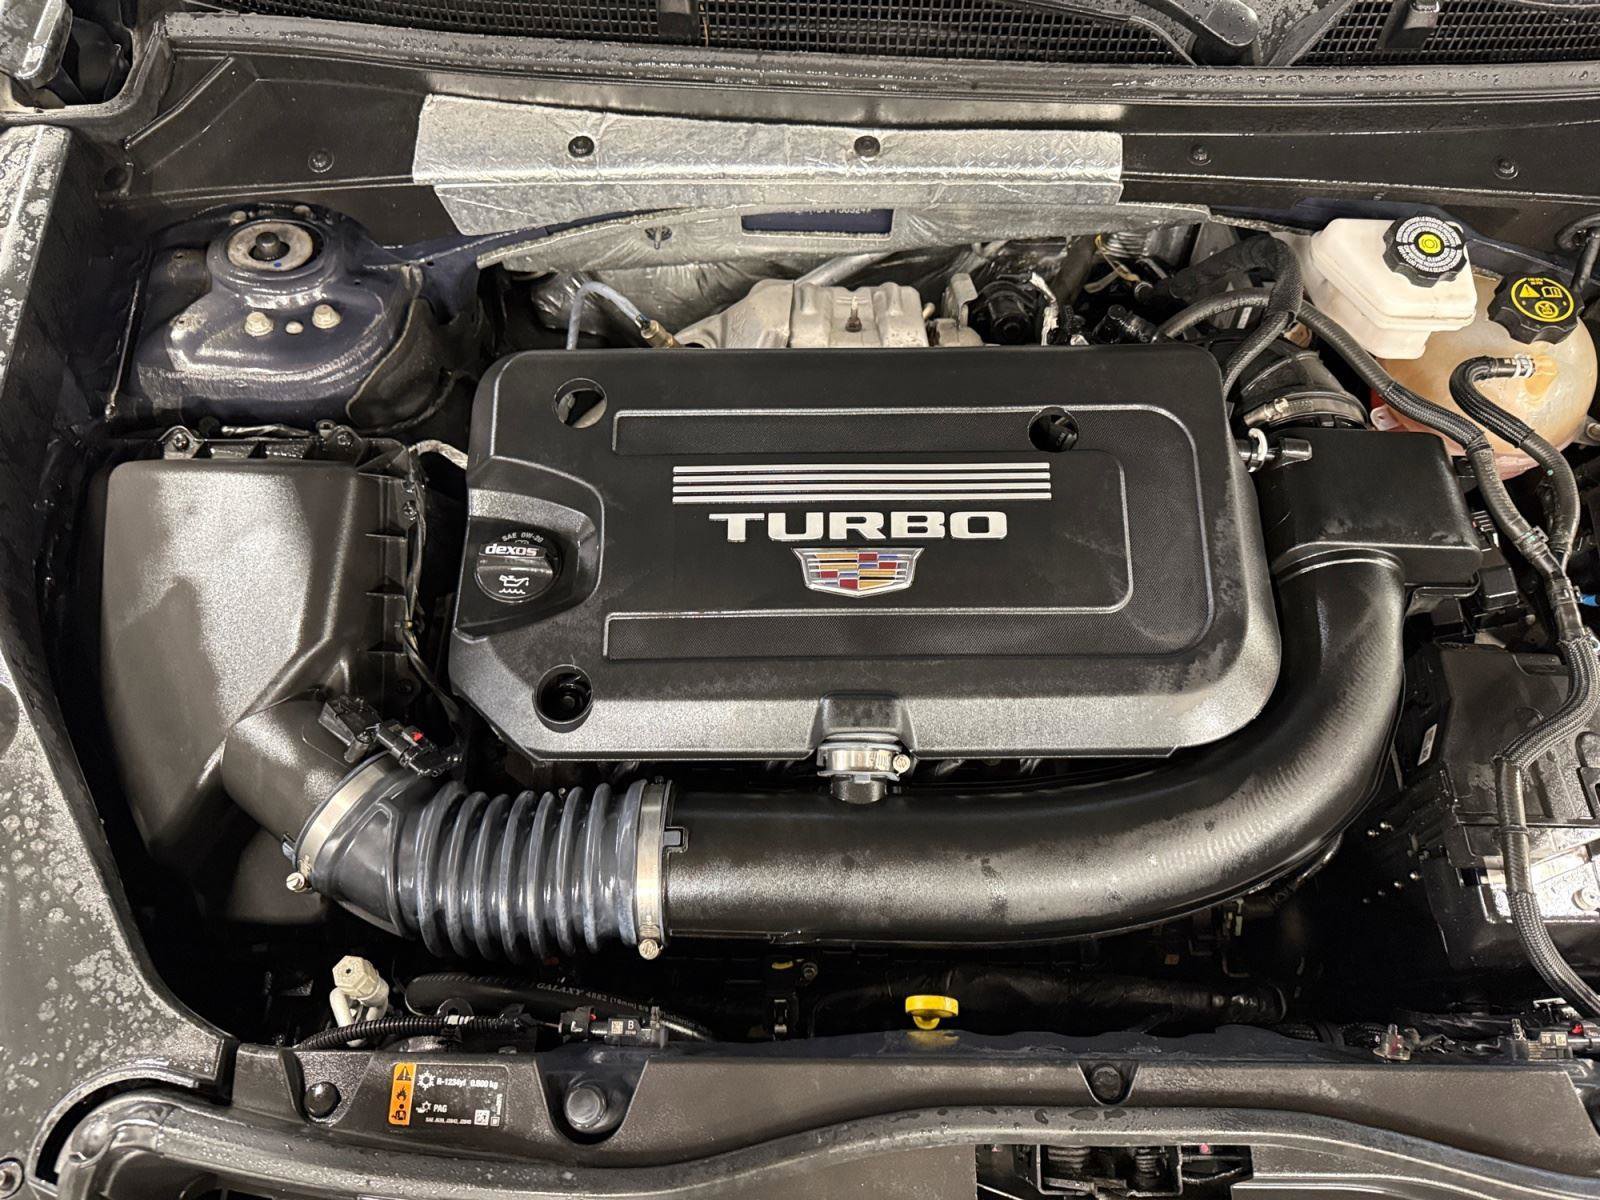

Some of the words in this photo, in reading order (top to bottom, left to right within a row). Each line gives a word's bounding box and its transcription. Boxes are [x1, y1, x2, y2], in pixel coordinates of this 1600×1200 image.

[709, 511, 1007, 542] TURBO
[502, 532, 517, 541] SAE
[485, 543, 539, 556] dexos
[537, 982, 584, 996] GALAXY
[628, 1020, 634, 1030] B
[433, 1104, 448, 1112] PAG
